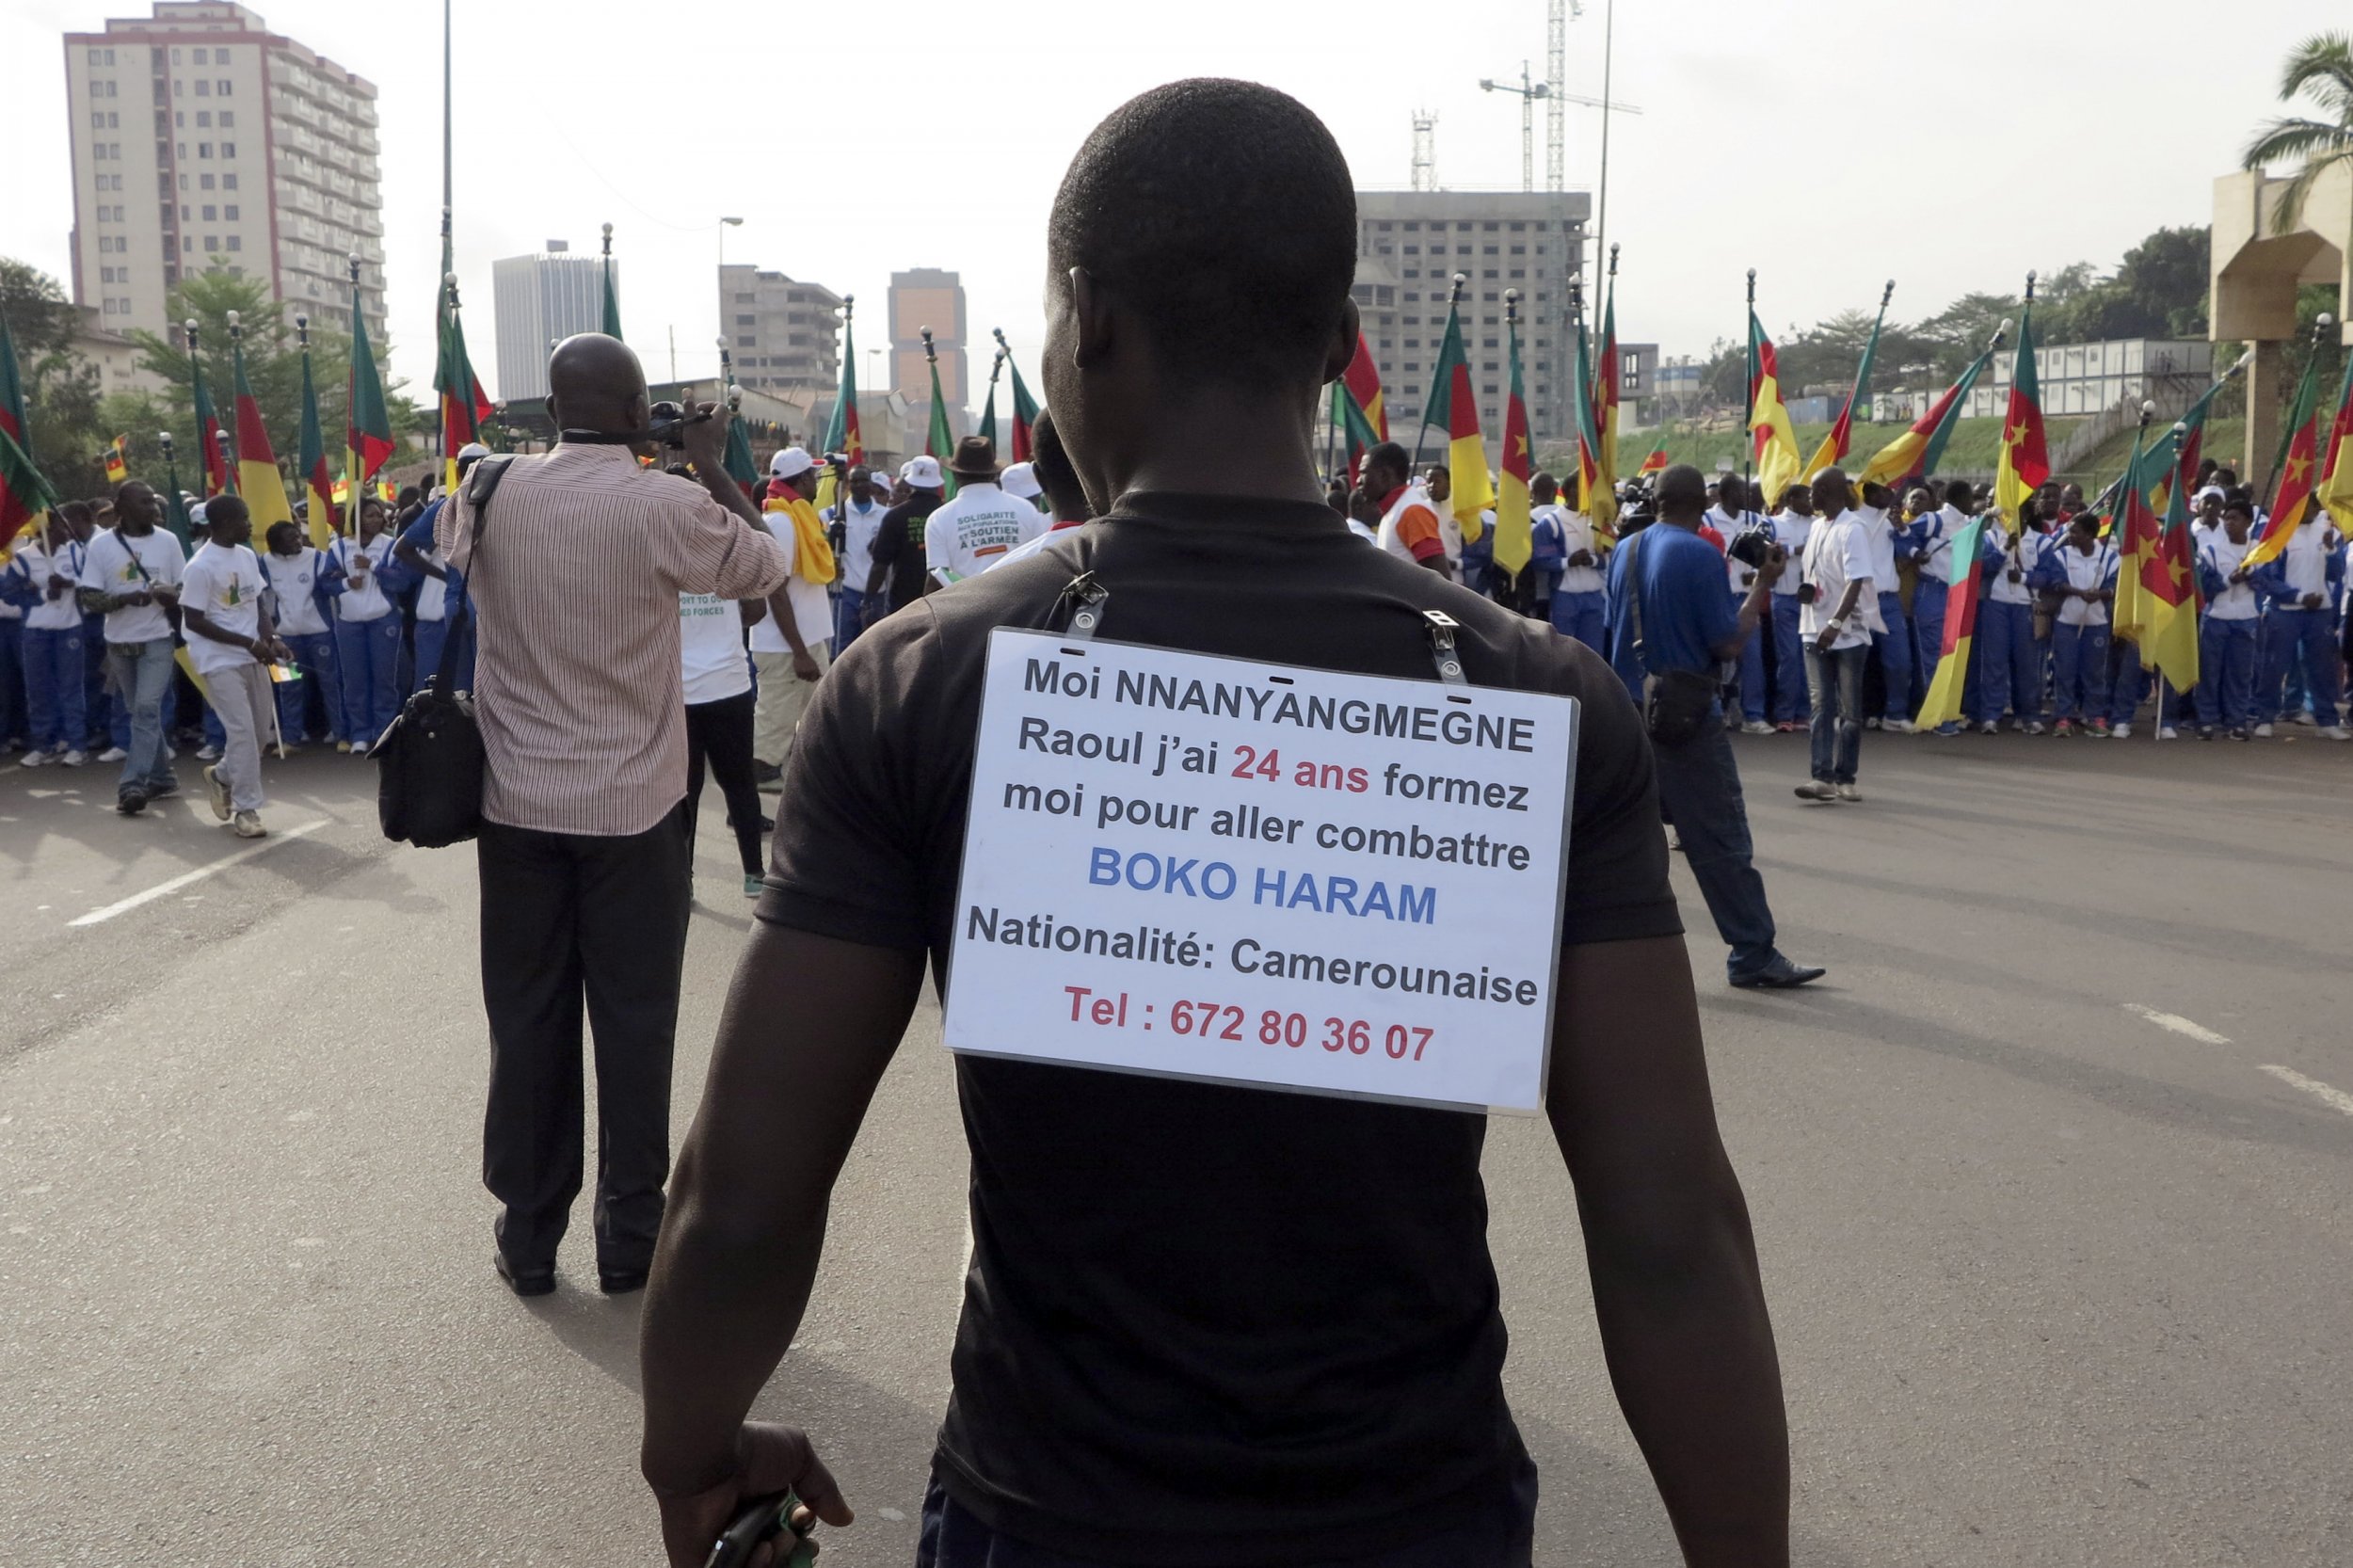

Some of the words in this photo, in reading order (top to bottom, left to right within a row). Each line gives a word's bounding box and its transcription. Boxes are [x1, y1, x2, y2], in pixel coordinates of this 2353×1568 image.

[970, 526, 1018, 537] SOUTIEN
[680, 596, 695, 604] ORT
[696, 595, 709, 604] TO
[693, 606, 724, 616] FORCES
[1024, 658, 1101, 700] Moi
[1114, 669, 1535, 754] NNANYANGMEGNE
[1018, 716, 1144, 765] Raoul
[1231, 744, 1281, 782] 24
[1293, 760, 1369, 793] ans
[1383, 762, 1529, 812] formez
[1003, 782, 1084, 817] moi
[1096, 794, 1200, 831] pour
[1210, 804, 1305, 844] aller
[1316, 823, 1530, 872] combattre
[1088, 846, 1238, 901] BOKO
[1254, 867, 1437, 925] HARAM
[967, 904, 1214, 969] Nationalité:
[1230, 937, 1538, 1006] Camerounaise
[1064, 985, 1128, 1028] Tel
[1144, 1004, 1154, 1031] :
[1170, 1000, 1245, 1042] 672
[1258, 1010, 1307, 1048] 80
[1321, 1016, 1371, 1055] 36
[1385, 1024, 1434, 1062] 07
